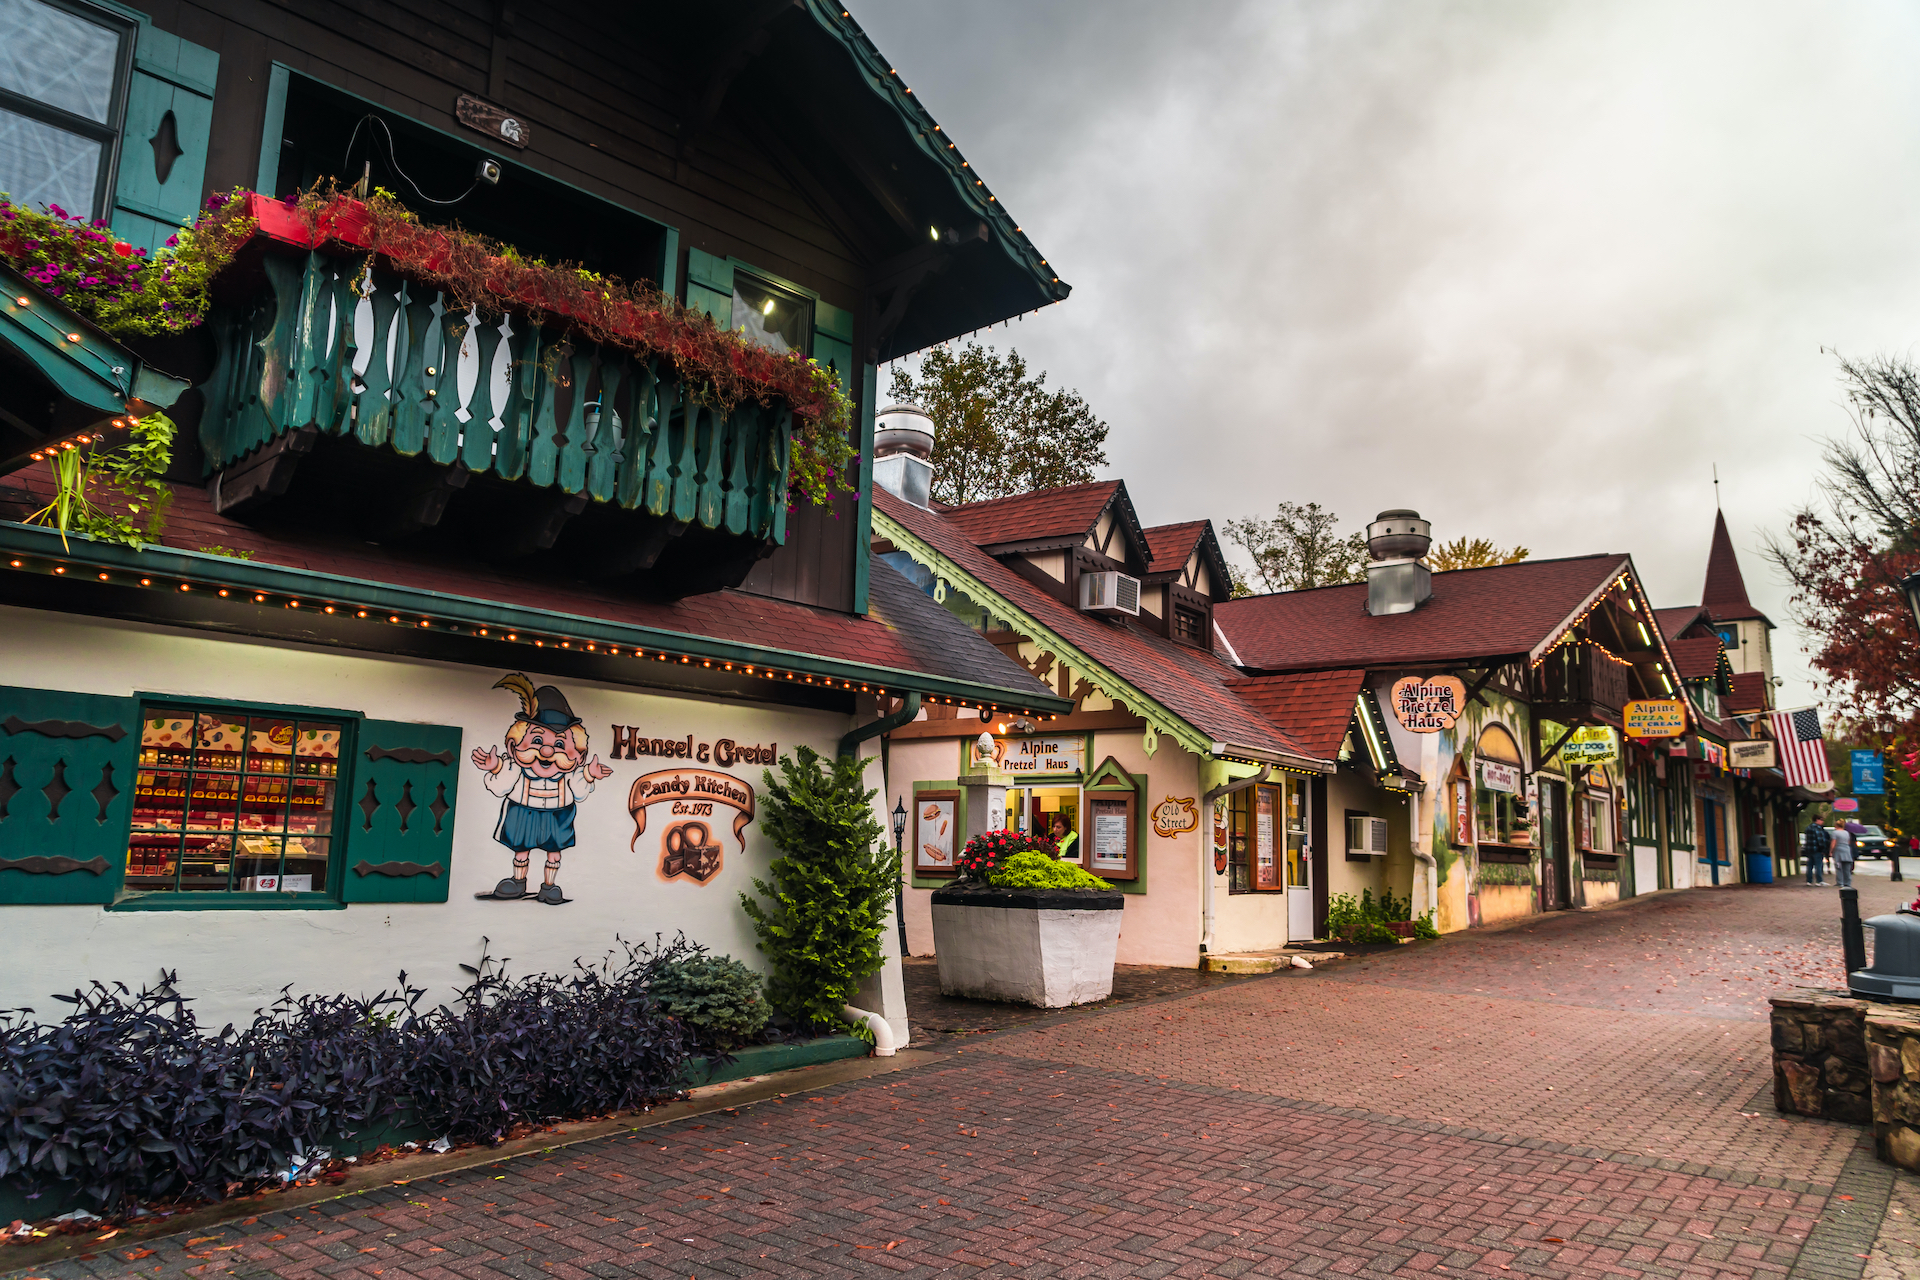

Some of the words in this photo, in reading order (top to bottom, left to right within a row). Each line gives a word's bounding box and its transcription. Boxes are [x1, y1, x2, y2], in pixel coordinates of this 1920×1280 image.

[1399, 683, 1452, 701] Alpine
[1398, 698, 1458, 714] Pretzel
[1633, 703, 1676, 714] Alpine
[1403, 714, 1447, 728] Haus
[609, 723, 693, 761] Hansel
[696, 742, 710, 764] &
[713, 738, 778, 768] Gretel
[1020, 740, 1059, 758] Alpine
[1585, 743, 1606, 751] DOG
[1563, 750, 1587, 761] GRILL
[1587, 751, 1616, 763] BURGER
[1004, 759, 1037, 770] Pretzel
[1046, 758, 1069, 769] Haus
[640, 775, 690, 798] Candy
[694, 775, 747, 805] Kitchen
[1162, 804, 1180, 816] Old
[1160, 816, 1187, 829] Street
